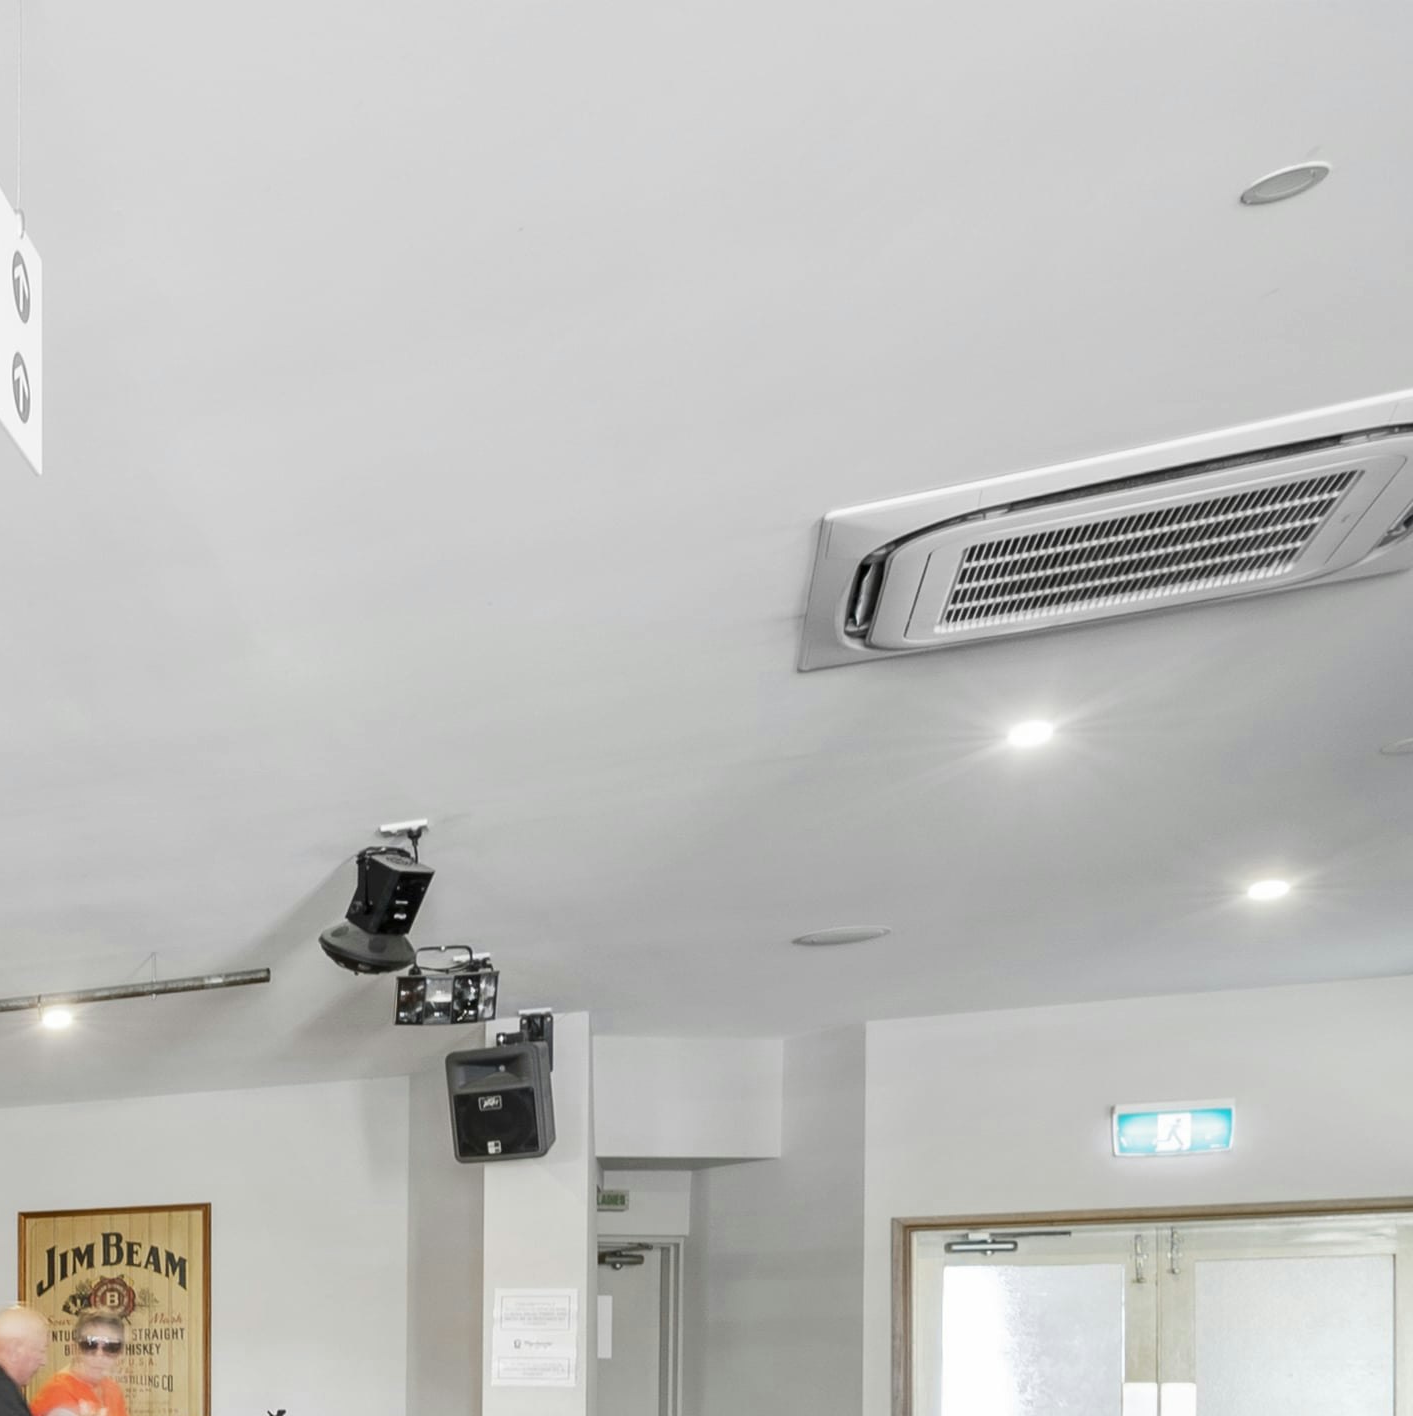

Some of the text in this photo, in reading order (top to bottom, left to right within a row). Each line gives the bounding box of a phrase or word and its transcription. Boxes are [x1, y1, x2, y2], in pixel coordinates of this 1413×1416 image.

[36, 1232, 187, 1297] JIM BEAM
[106, 1292, 119, 1306] B
[132, 1327, 186, 1341] STRAIGHT
[125, 1343, 162, 1356] HISKEY
